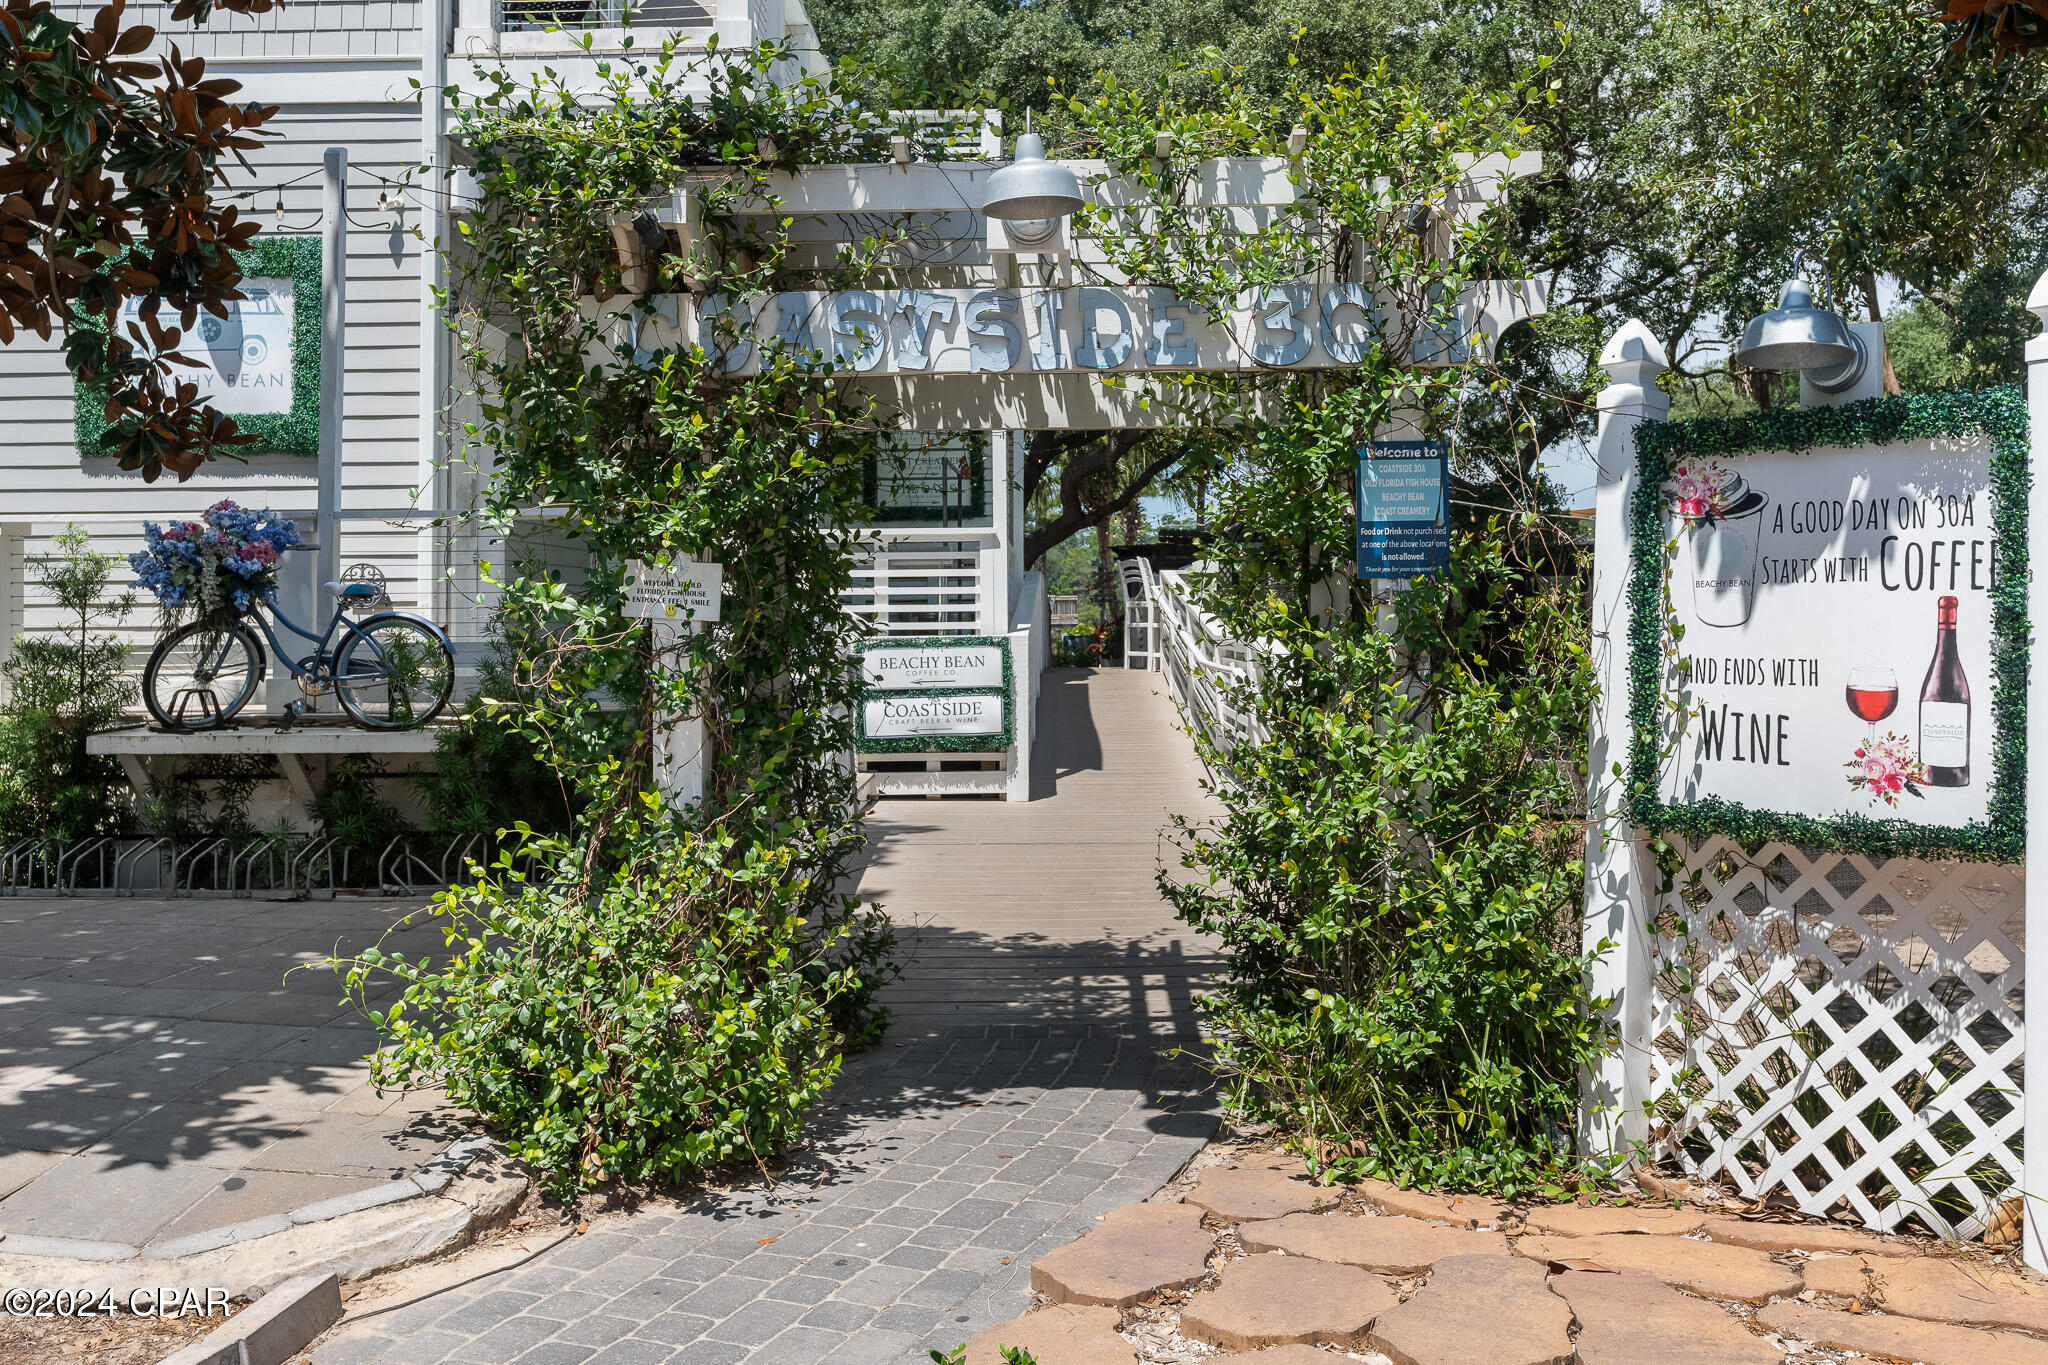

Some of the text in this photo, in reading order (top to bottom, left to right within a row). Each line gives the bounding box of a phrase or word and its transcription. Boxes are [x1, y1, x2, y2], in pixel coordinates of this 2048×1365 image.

[227, 373, 284, 388] BEAN
[1366, 447, 1438, 458] elcome to
[1378, 464, 1426, 473] COASTSIDE 30A
[1365, 478, 1441, 488] OLD FLORIDA FISH HOUSE
[1382, 492, 1425, 501] BEACHY BEAN
[1375, 506, 1431, 516] COAST CREAMERY
[1772, 503, 1784, 533] A
[1791, 500, 1844, 533] GOOD
[1852, 498, 1890, 531] DAY
[1935, 494, 1975, 529] 30A
[1360, 527, 1376, 536] Food
[1384, 527, 1403, 536] Drink
[1381, 540, 1388, 548] of
[1388, 540, 1399, 548] the
[1400, 540, 1418, 548] above
[1419, 540, 1447, 548] locatons
[1381, 552, 1387, 561] is
[1387, 553, 1399, 561] not
[1695, 579, 1751, 588] BEACHY BEAN
[879, 655, 985, 670] BEACHY BEAN
[905, 669, 939, 677] COFFEE
[1683, 654, 1819, 687] AND ENDS WITH
[884, 701, 983, 718] COASTSIDE
[888, 718, 916, 726] CRAFT
[920, 717, 941, 725] BEER
[1700, 703, 1790, 766] WINE
